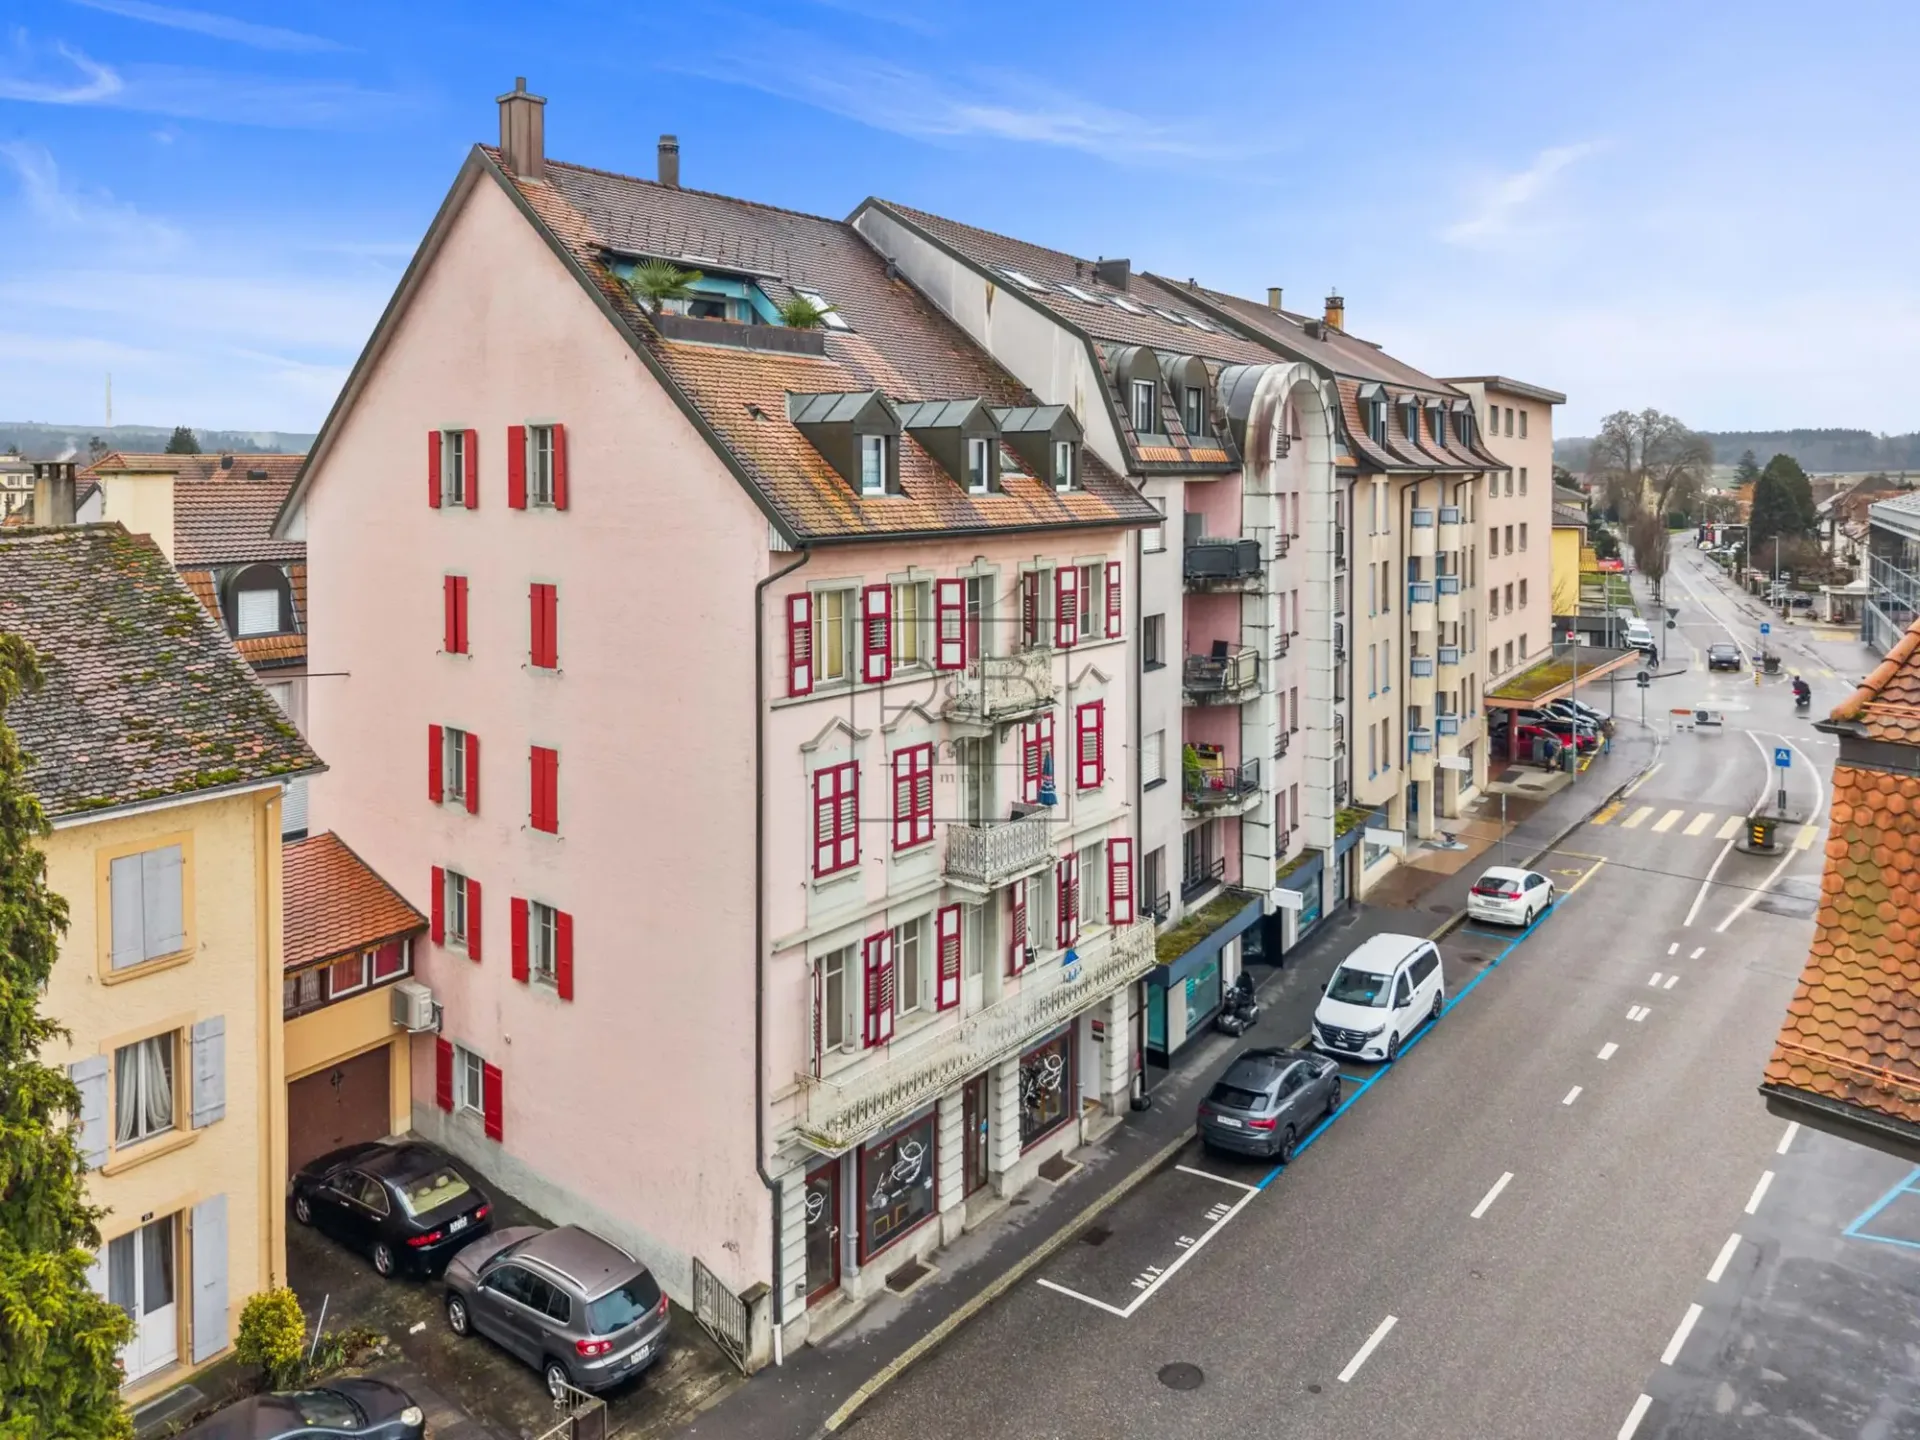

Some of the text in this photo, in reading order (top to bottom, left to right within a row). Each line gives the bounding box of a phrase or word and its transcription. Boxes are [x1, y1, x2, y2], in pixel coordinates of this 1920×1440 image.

[1131, 1202, 1232, 1290] MAX 15 MIN
